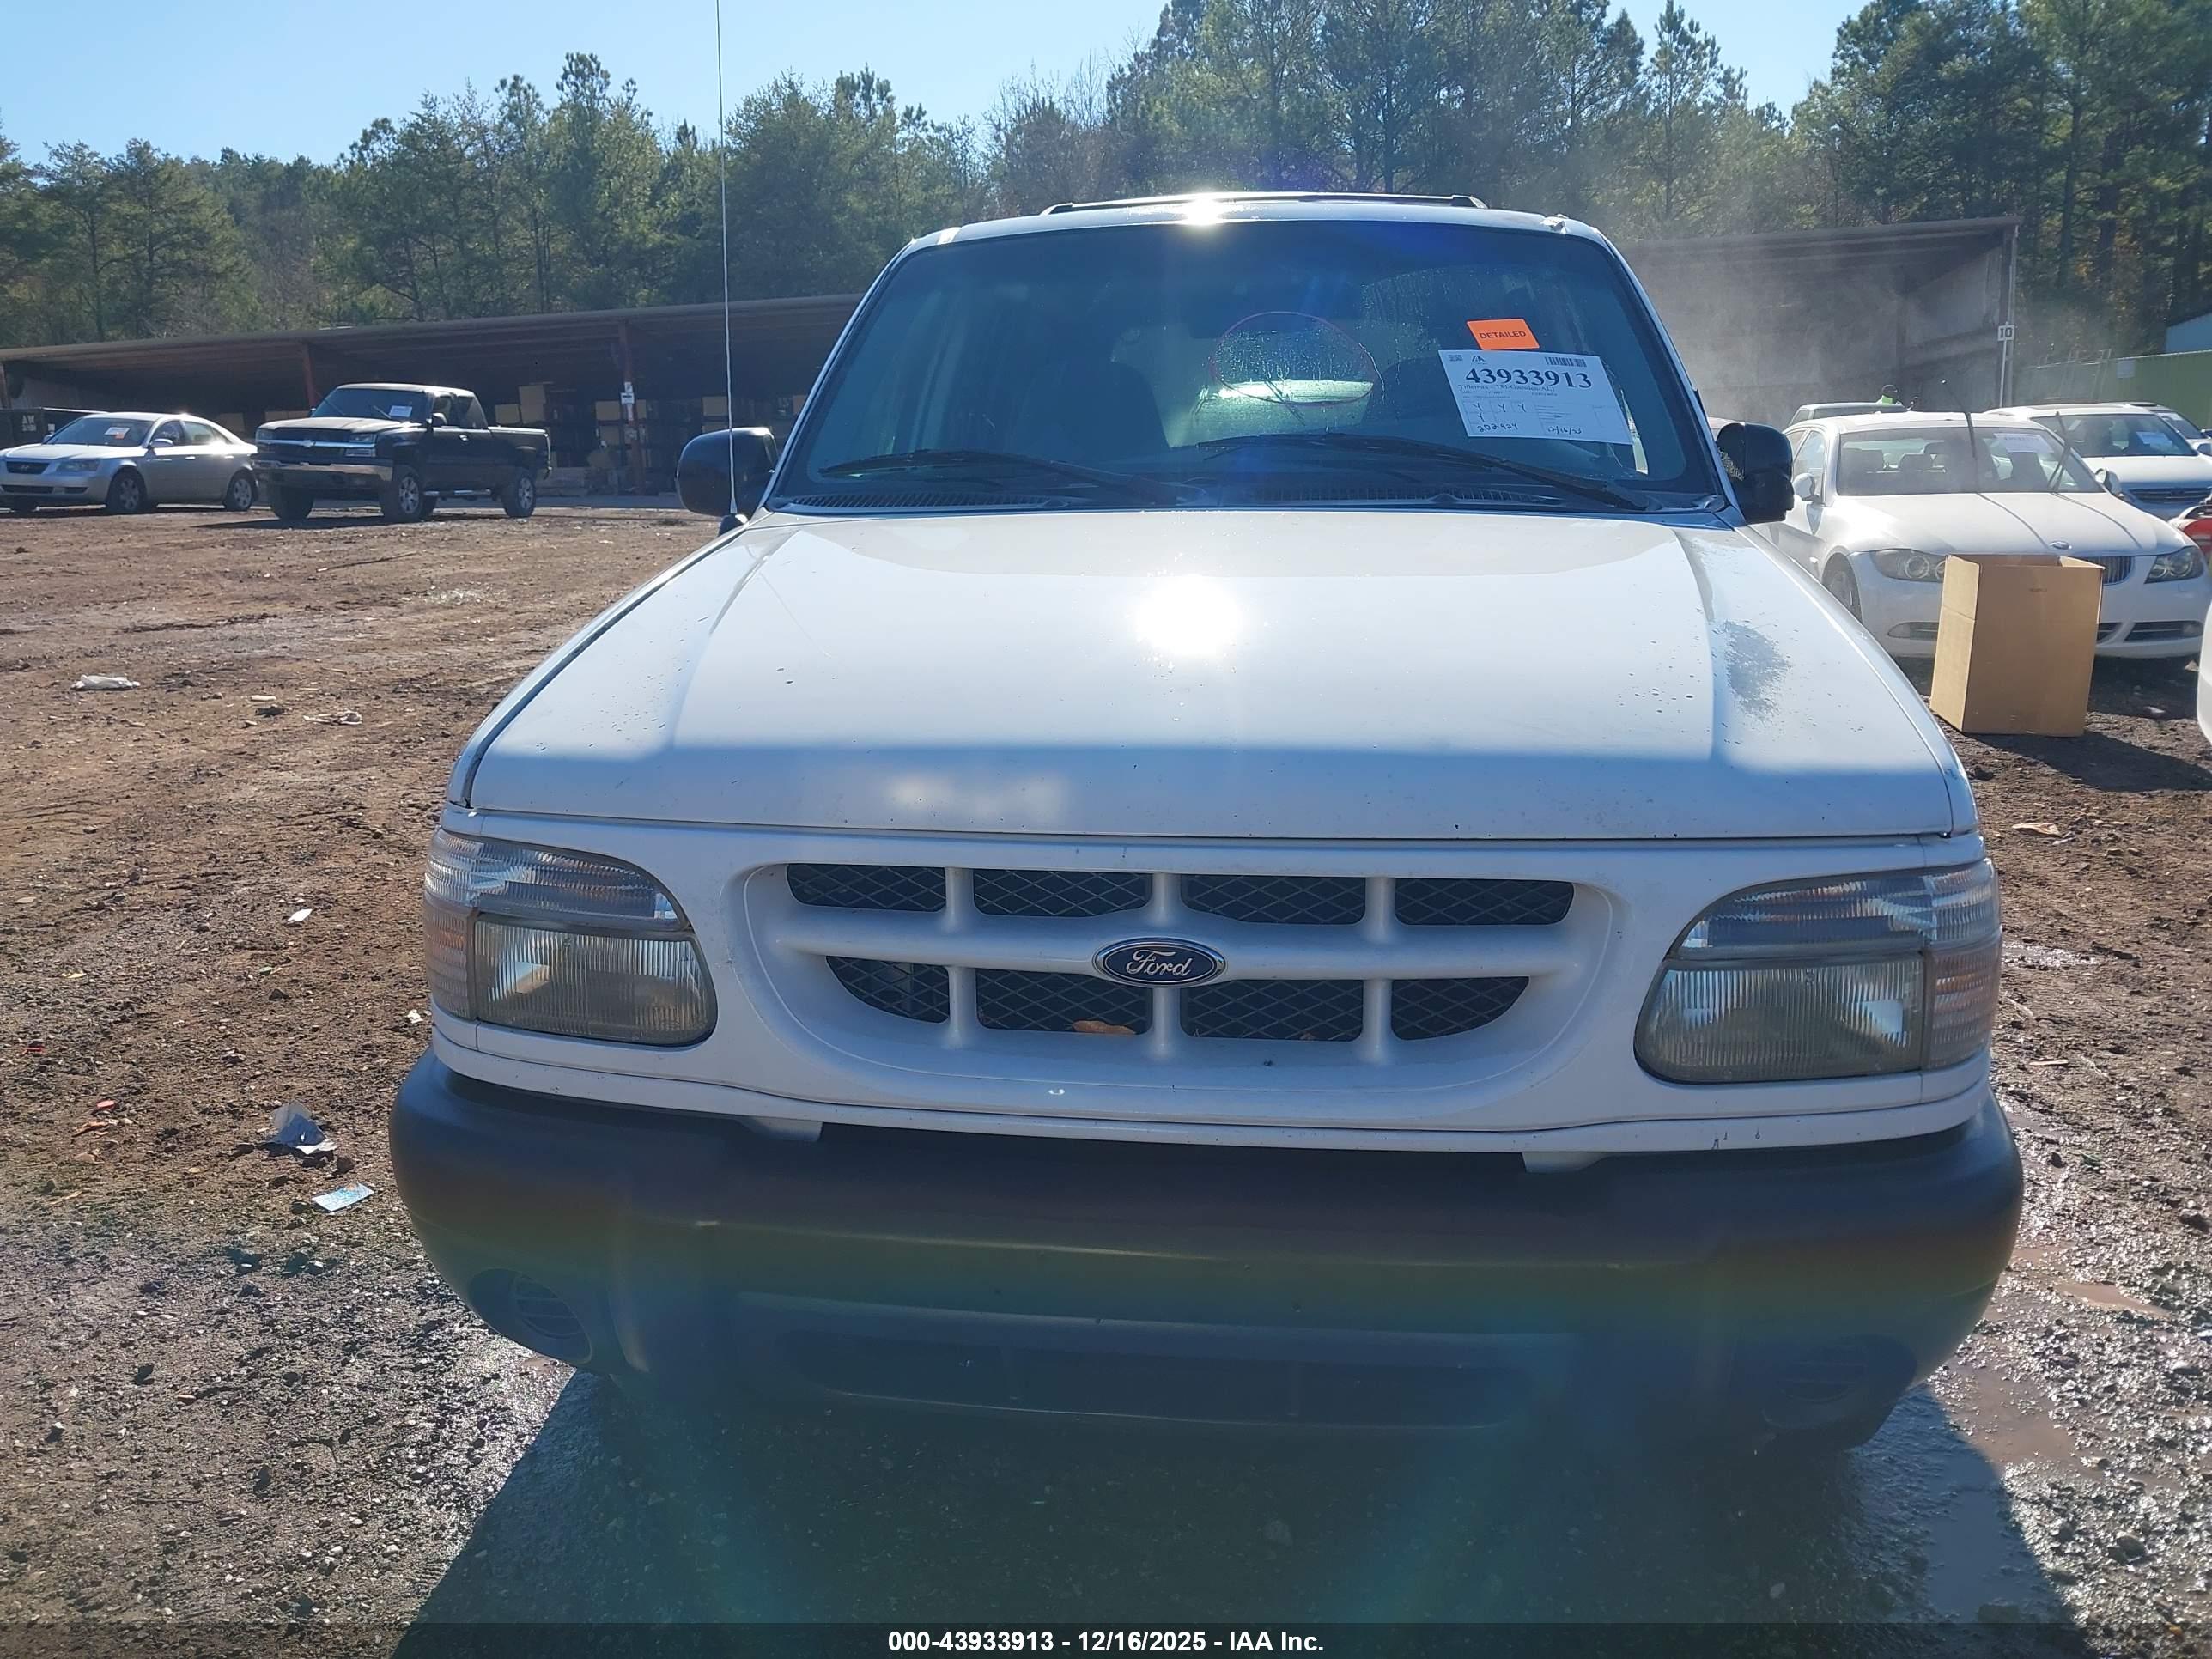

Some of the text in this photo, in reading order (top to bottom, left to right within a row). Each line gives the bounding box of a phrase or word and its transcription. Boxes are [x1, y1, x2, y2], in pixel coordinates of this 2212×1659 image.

[1479, 331, 1527, 339] DETAILED
[1999, 327, 2013, 338] 10
[1465, 368, 1592, 389] 43933913
[1126, 949, 1192, 976] Ford
